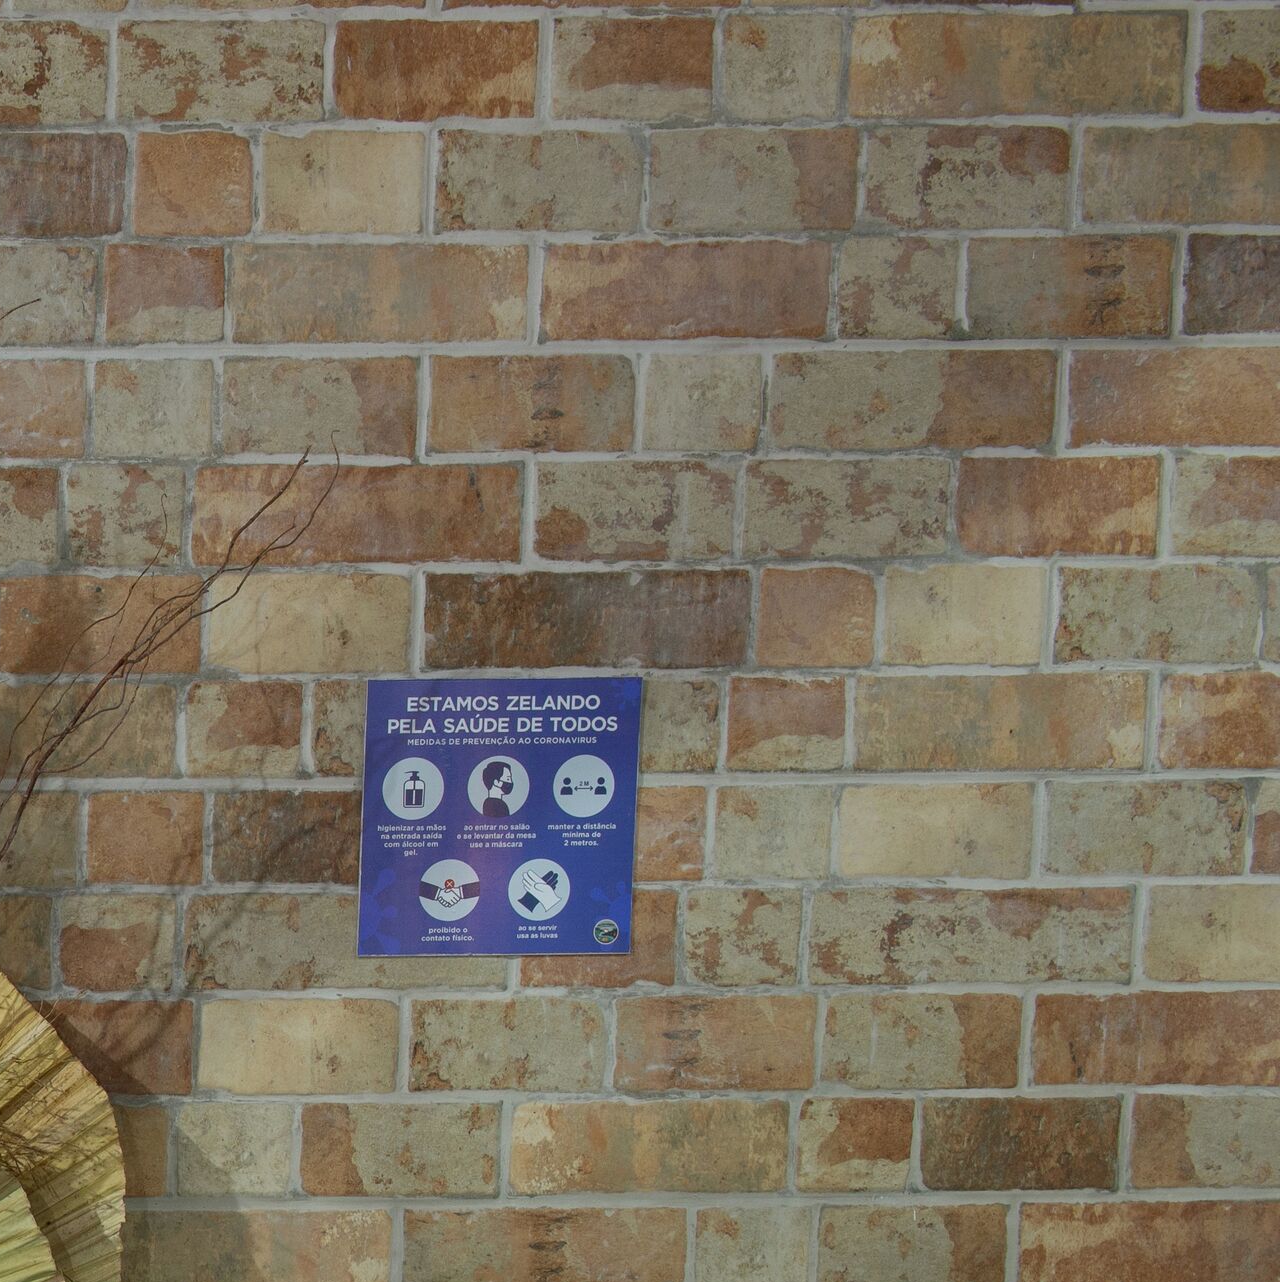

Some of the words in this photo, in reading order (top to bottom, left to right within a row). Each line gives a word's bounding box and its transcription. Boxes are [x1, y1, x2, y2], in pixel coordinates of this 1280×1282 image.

[407, 697, 499, 712] ESTAMOS
[506, 695, 600, 711] ZELANDO
[387, 719, 436, 734] PELA
[443, 714, 509, 733] SAÚDE
[517, 717, 543, 732] DE
[550, 716, 618, 732] TODOS
[407, 738, 447, 746] MEDIDAS
[462, 736, 516, 747] PREVENÇÃO
[518, 737, 532, 745] AO
[533, 736, 597, 744] CORONAVIRUS
[402, 840, 425, 848] álcool
[491, 840, 523, 848] máscara
[428, 926, 461, 935] proibido
